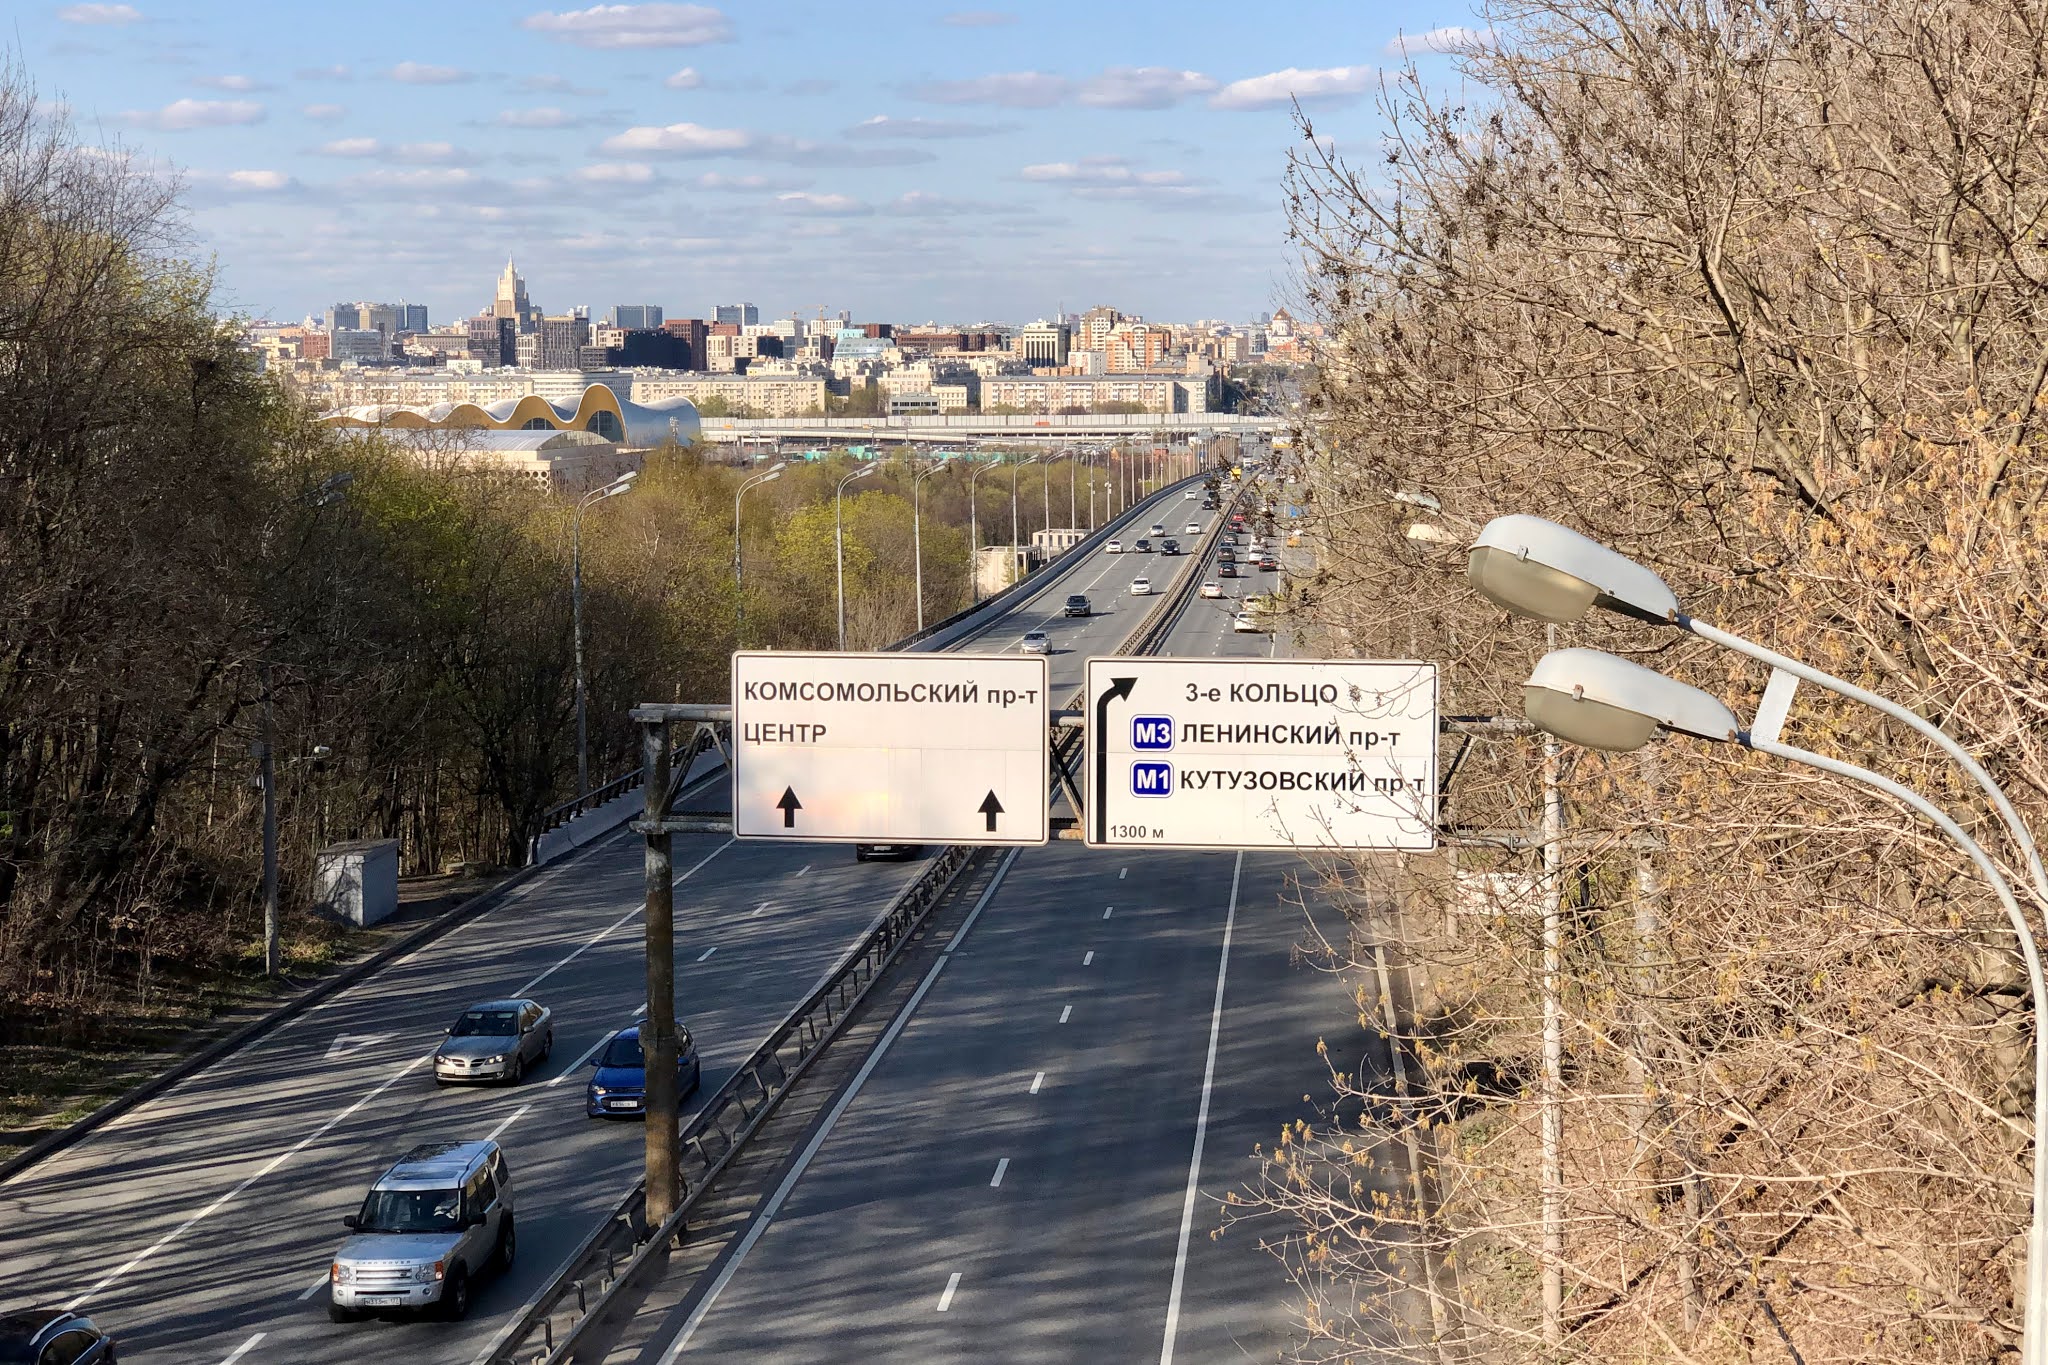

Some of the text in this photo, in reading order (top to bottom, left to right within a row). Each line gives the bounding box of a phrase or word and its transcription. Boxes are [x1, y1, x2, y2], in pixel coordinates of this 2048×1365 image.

[745, 680, 1038, 709] КОМСОМОЛЬСКИЙ пр-т
[1185, 682, 1338, 707] 3-е КОЛЬЦО
[744, 722, 827, 746] ЦЕНТР
[1136, 720, 1401, 750] М3 ЛЕНИНСКИЙ пр-т
[1137, 768, 1170, 790] М1
[1180, 769, 1365, 791] КУТУЗОВСКИЙ
[1110, 825, 1164, 839] 1300 м
